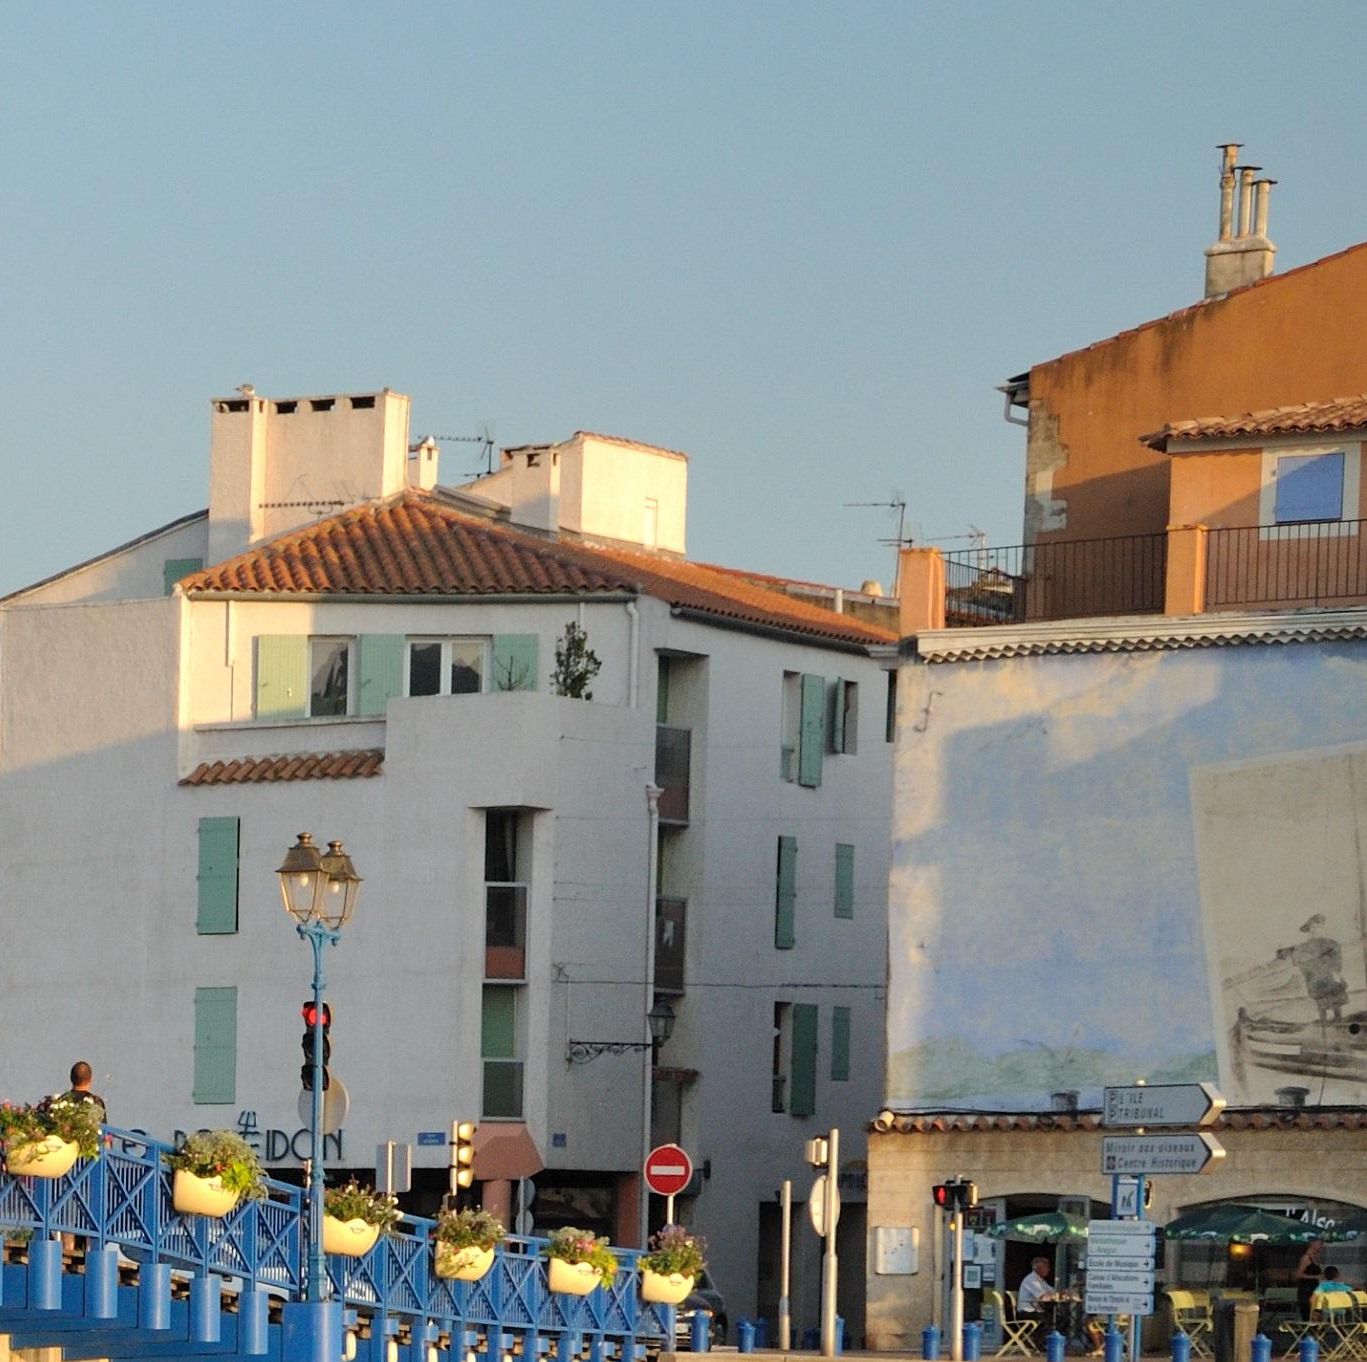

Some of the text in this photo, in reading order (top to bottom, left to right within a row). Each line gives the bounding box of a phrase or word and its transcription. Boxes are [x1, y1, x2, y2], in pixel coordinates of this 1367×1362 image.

[1118, 1107, 1164, 1119] TRIBUNAL
[1118, 1157, 1197, 1169] Centre Historique
